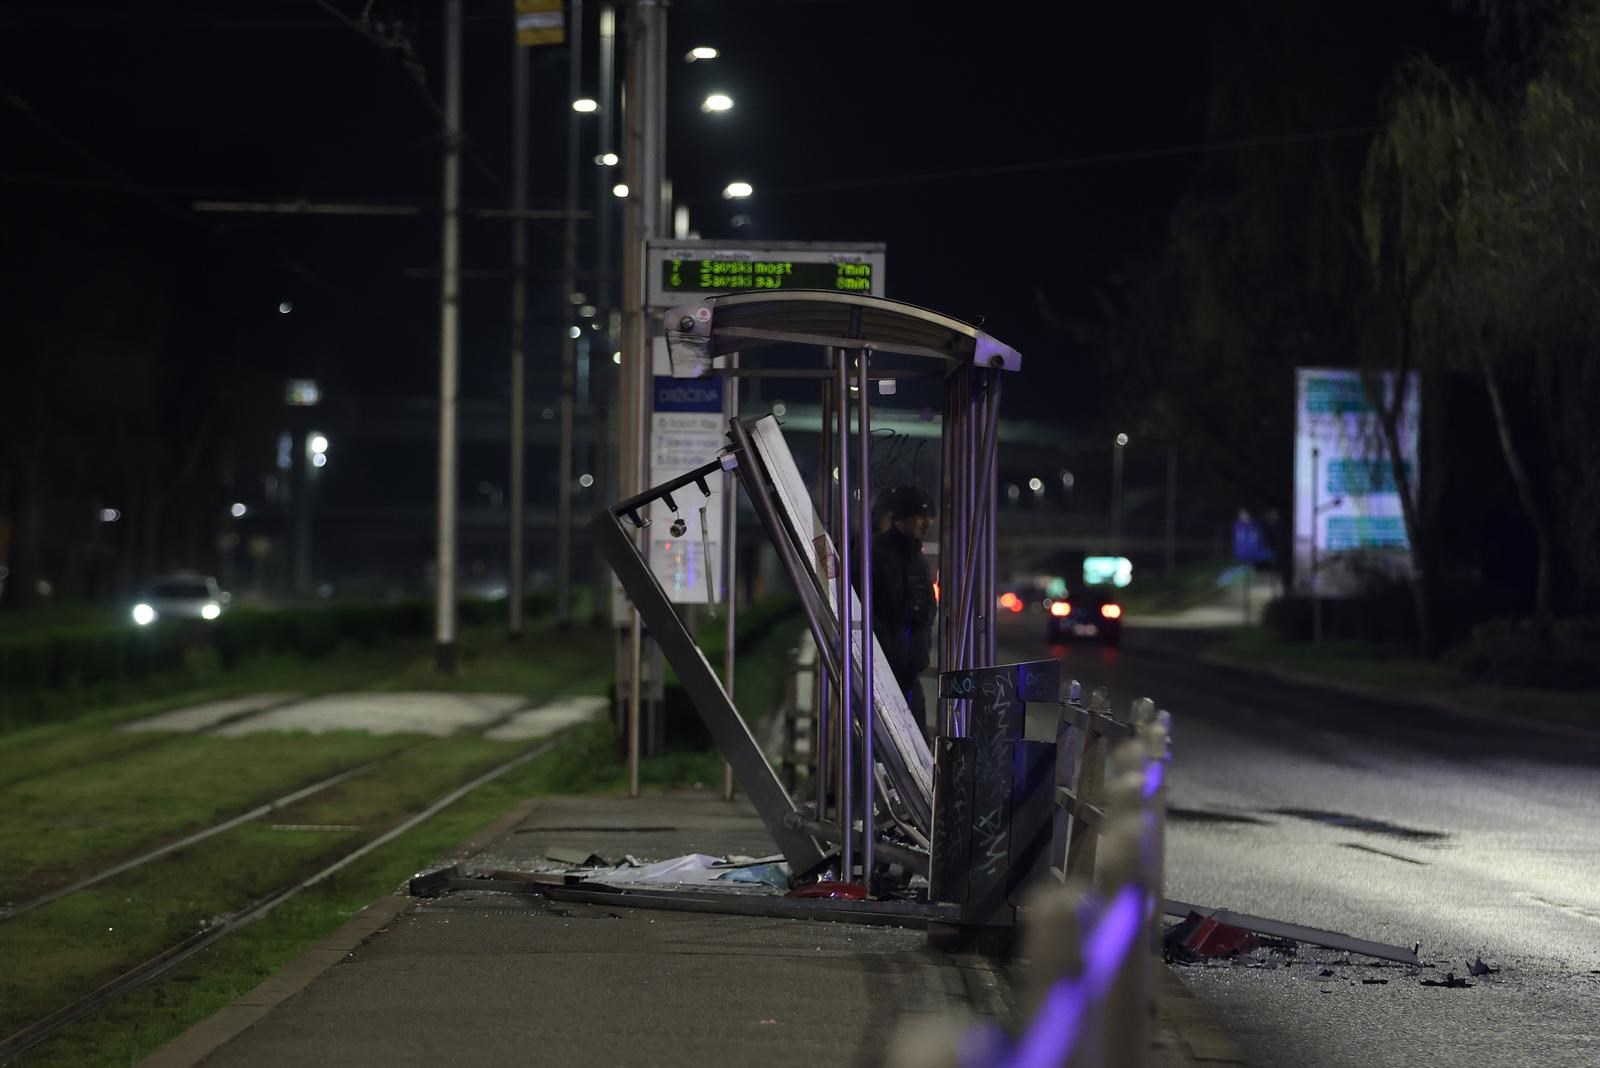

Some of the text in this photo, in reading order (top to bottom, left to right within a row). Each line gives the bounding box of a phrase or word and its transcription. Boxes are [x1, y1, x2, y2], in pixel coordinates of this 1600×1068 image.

[700, 259, 752, 274] Savski
[754, 261, 792, 275] most
[700, 274, 752, 288] Savski
